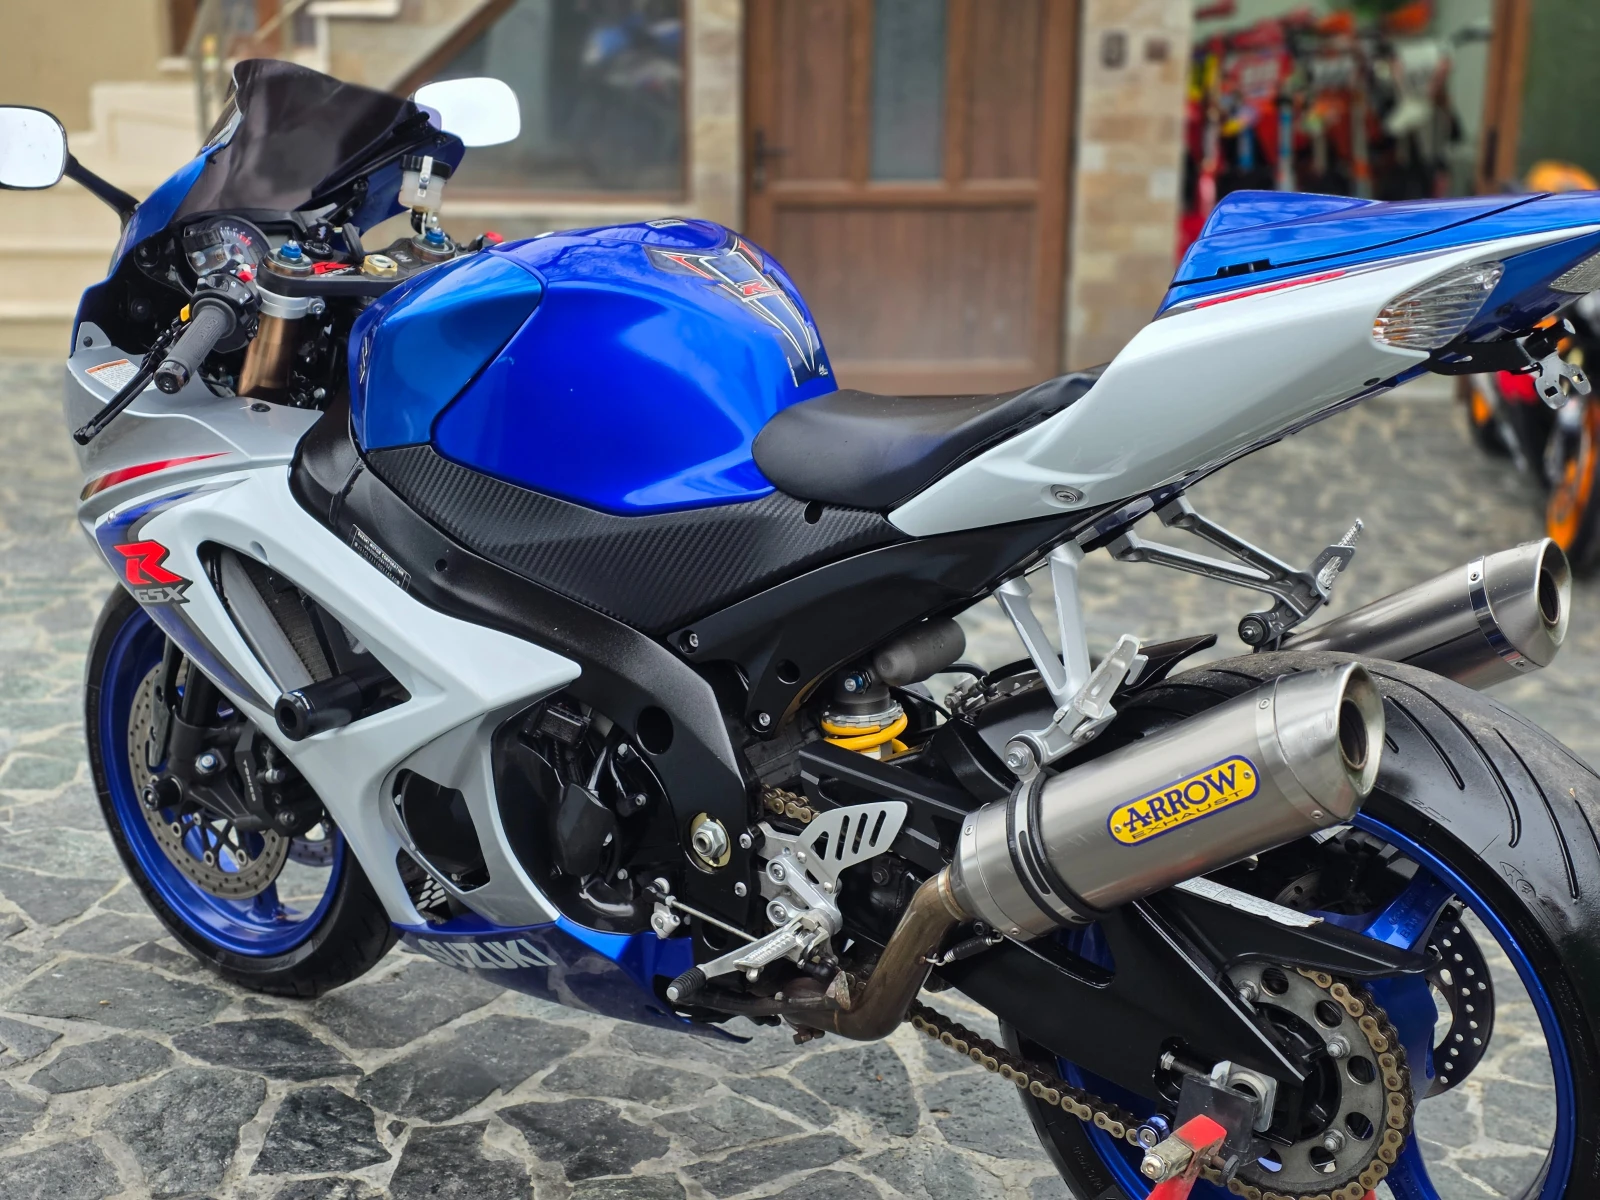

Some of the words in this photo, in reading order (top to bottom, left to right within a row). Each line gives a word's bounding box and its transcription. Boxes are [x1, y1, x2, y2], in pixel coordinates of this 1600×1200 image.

[113, 540, 183, 585] R
[134, 584, 186, 603] GSX
[1123, 763, 1237, 833] ARROW
[1132, 789, 1243, 840] EXHAUST
[417, 938, 557, 970] SUZUKI
